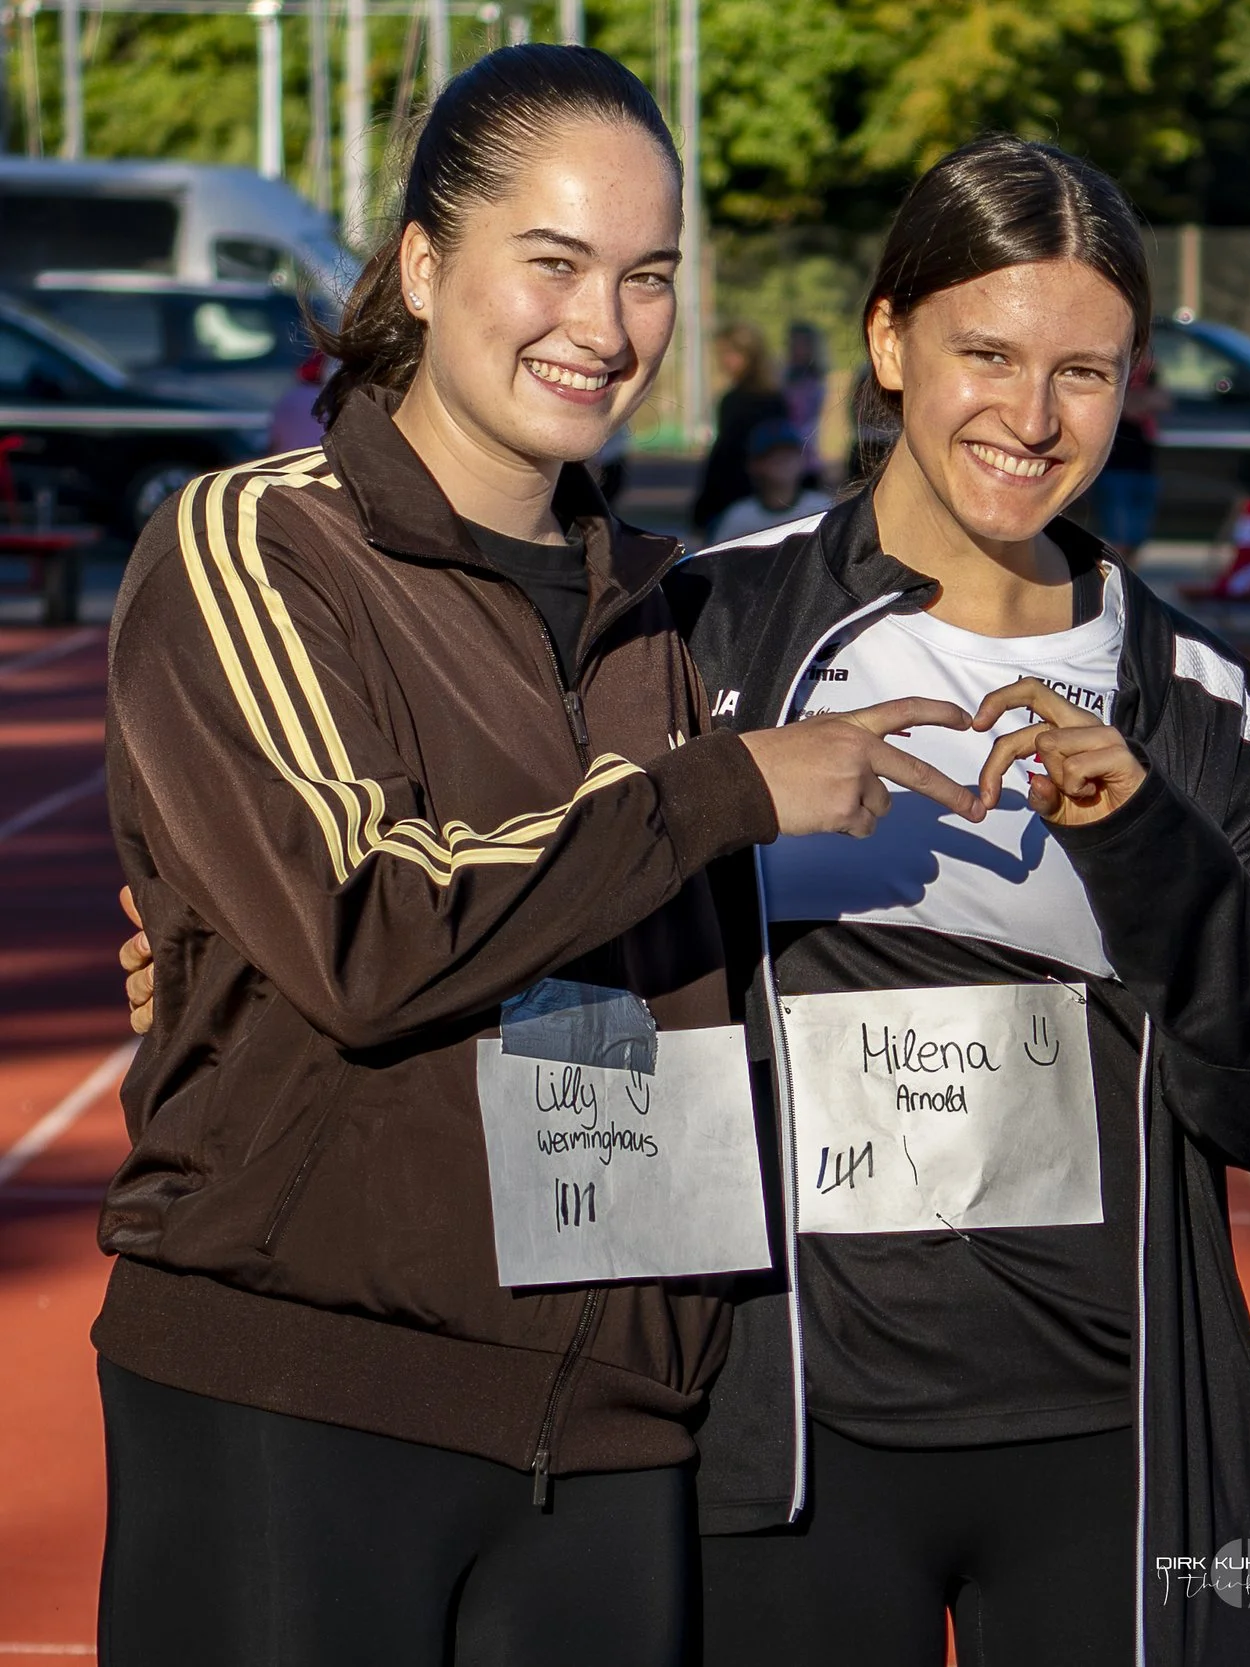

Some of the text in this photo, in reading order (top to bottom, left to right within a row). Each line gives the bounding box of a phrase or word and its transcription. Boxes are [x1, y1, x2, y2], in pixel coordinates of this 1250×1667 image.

[802, 665, 849, 682] rima
[861, 1022, 1002, 1074] Milena
[536, 1064, 598, 1131] Lilly
[896, 1084, 968, 1114] Arnold
